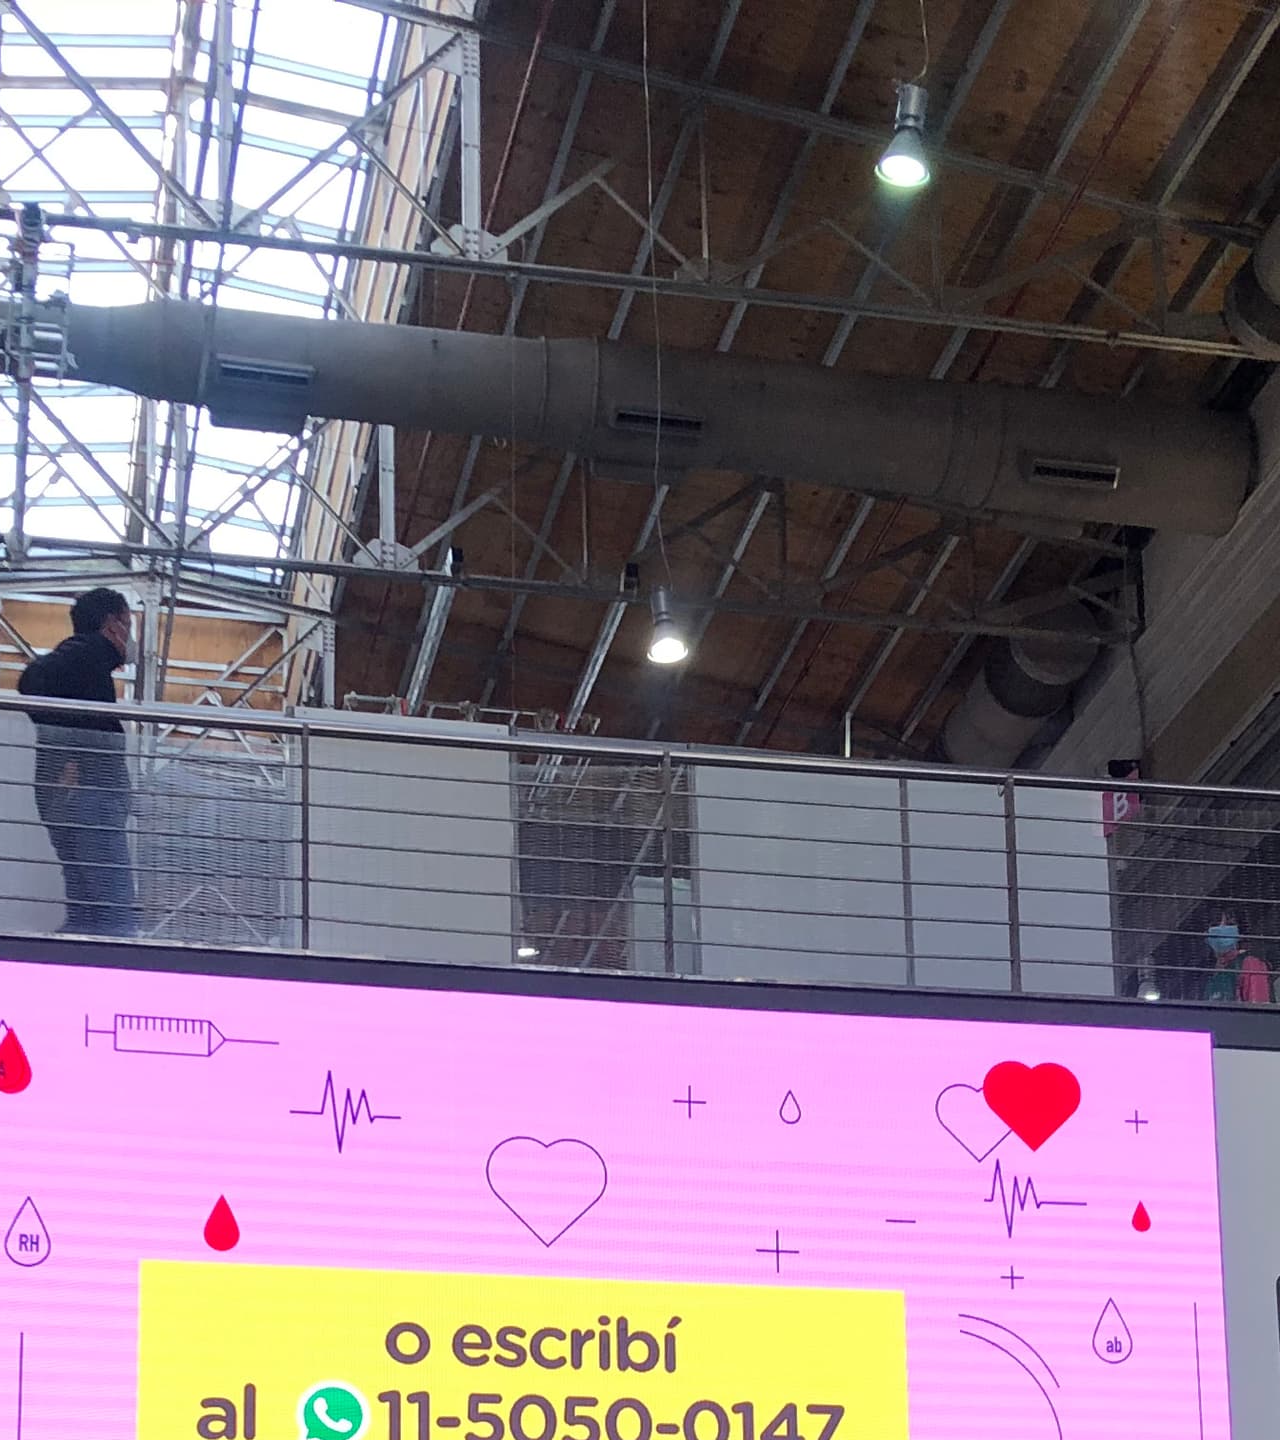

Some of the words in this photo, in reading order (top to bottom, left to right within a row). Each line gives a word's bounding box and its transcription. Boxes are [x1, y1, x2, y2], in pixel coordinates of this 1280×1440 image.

[19, 1233, 39, 1252] RH
[384, 1321, 431, 1365] o
[451, 1315, 683, 1374] escribí
[1106, 1336, 1122, 1353] ab
